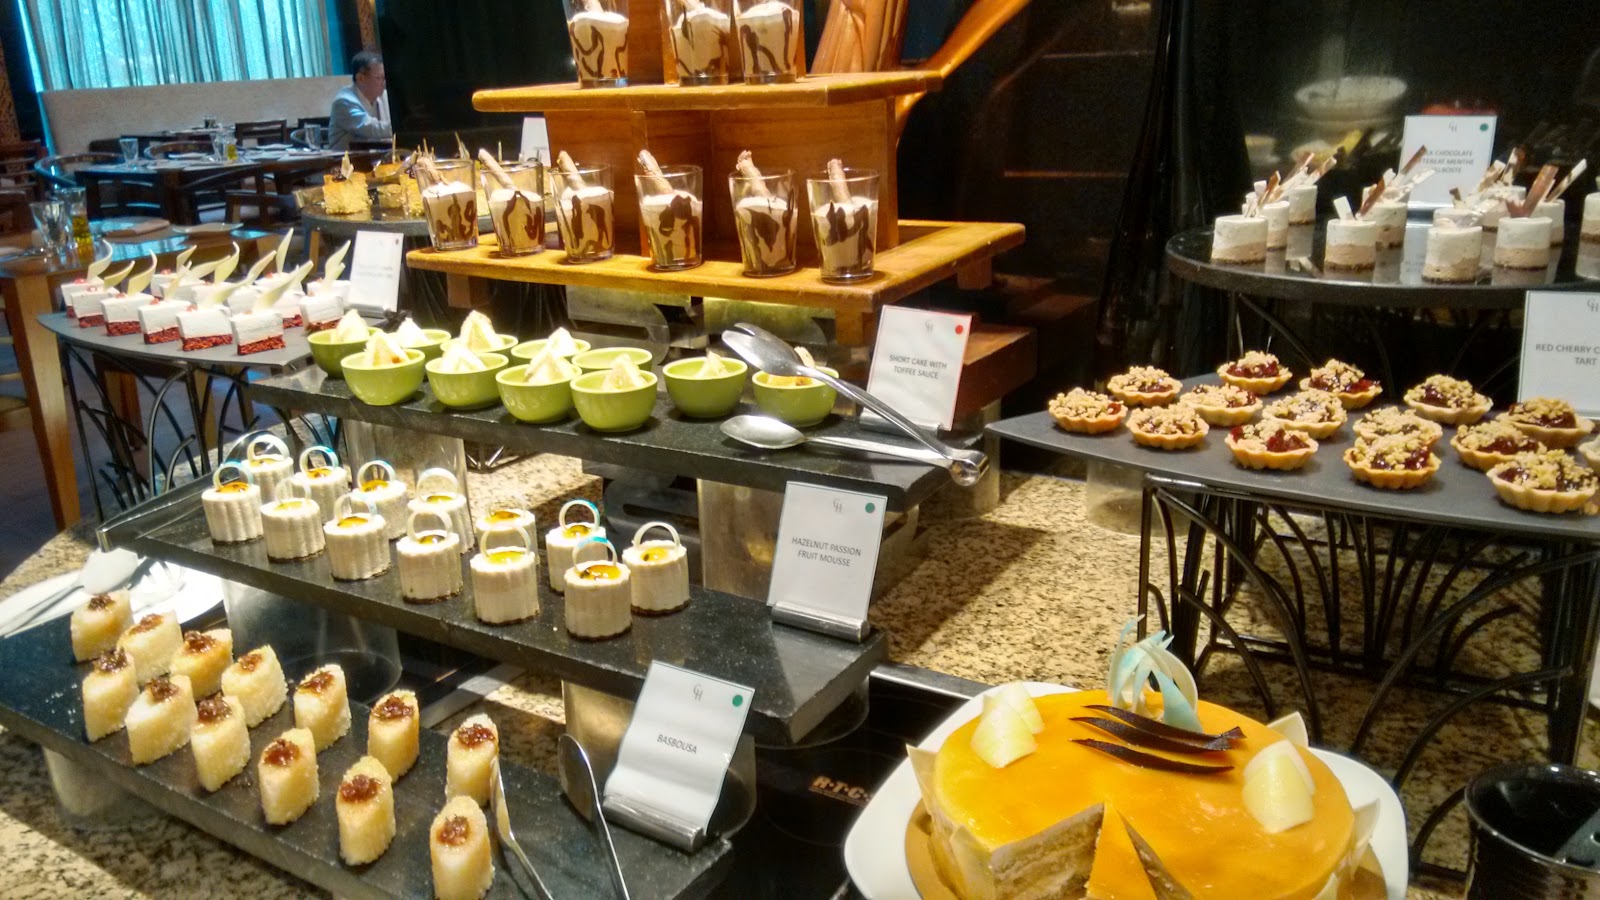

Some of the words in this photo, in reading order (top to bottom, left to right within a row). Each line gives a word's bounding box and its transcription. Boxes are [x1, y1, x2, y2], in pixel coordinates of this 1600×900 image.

[1535, 344, 1554, 352] RED
[1555, 344, 1592, 354] CHERRY
[889, 354, 911, 364] SHORT
[911, 358, 928, 367] CAKE
[929, 360, 948, 369] WITH
[1575, 356, 1597, 366] TART
[894, 365, 917, 376] TOFFEE
[917, 369, 939, 380] SAUCE
[791, 537, 829, 550] HAZELNUT
[829, 543, 862, 557] PASSION
[797, 549, 818, 561] FRUIT
[819, 553, 852, 567] MOUSSE
[656, 733, 699, 755] BASBOUSA
